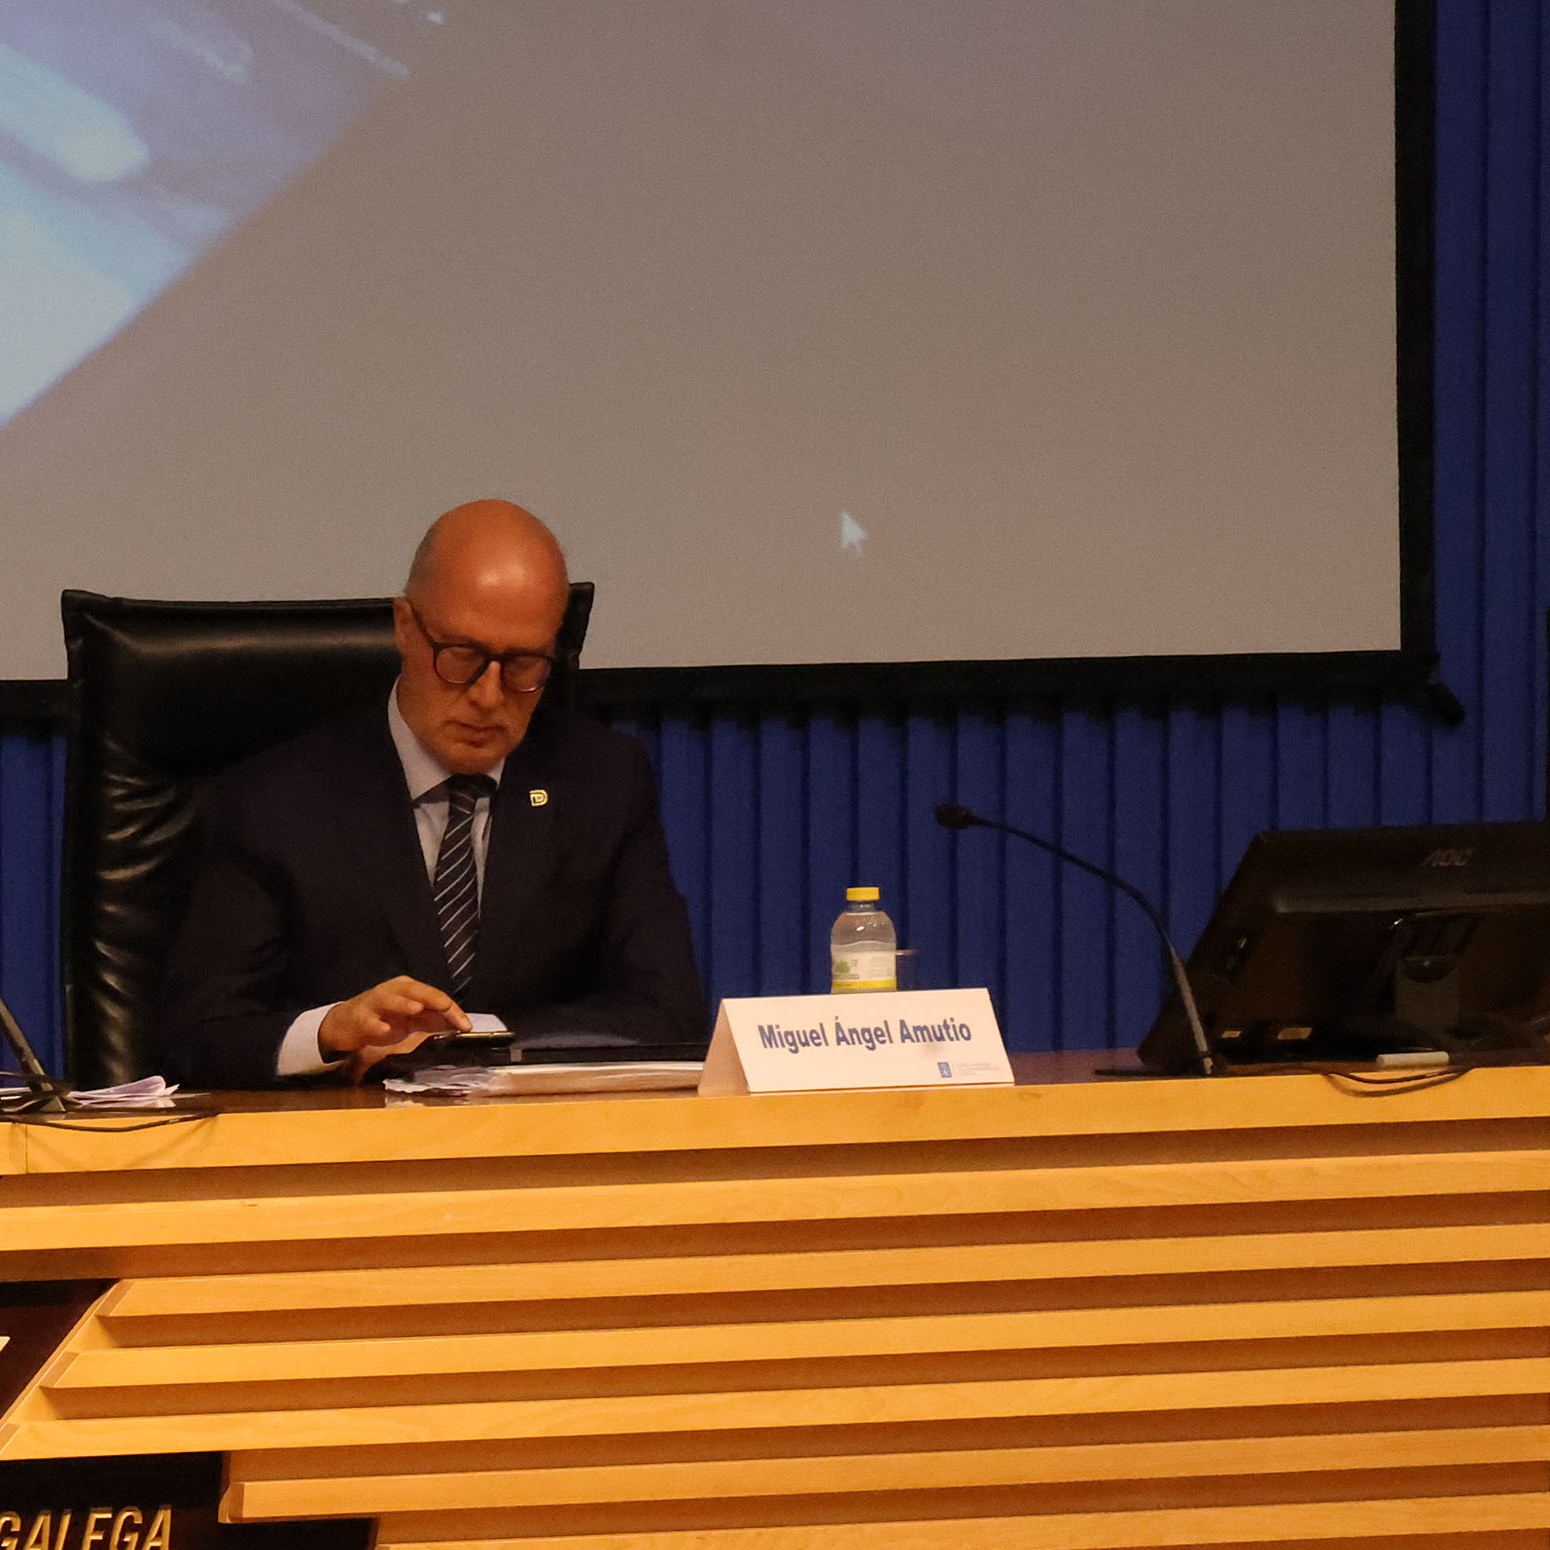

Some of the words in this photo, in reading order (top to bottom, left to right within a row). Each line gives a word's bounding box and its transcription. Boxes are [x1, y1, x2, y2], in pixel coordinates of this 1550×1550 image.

[758, 1023, 829, 1054] Miguel
[835, 1016, 893, 1052] Ángel
[900, 1018, 972, 1044] Amutio
